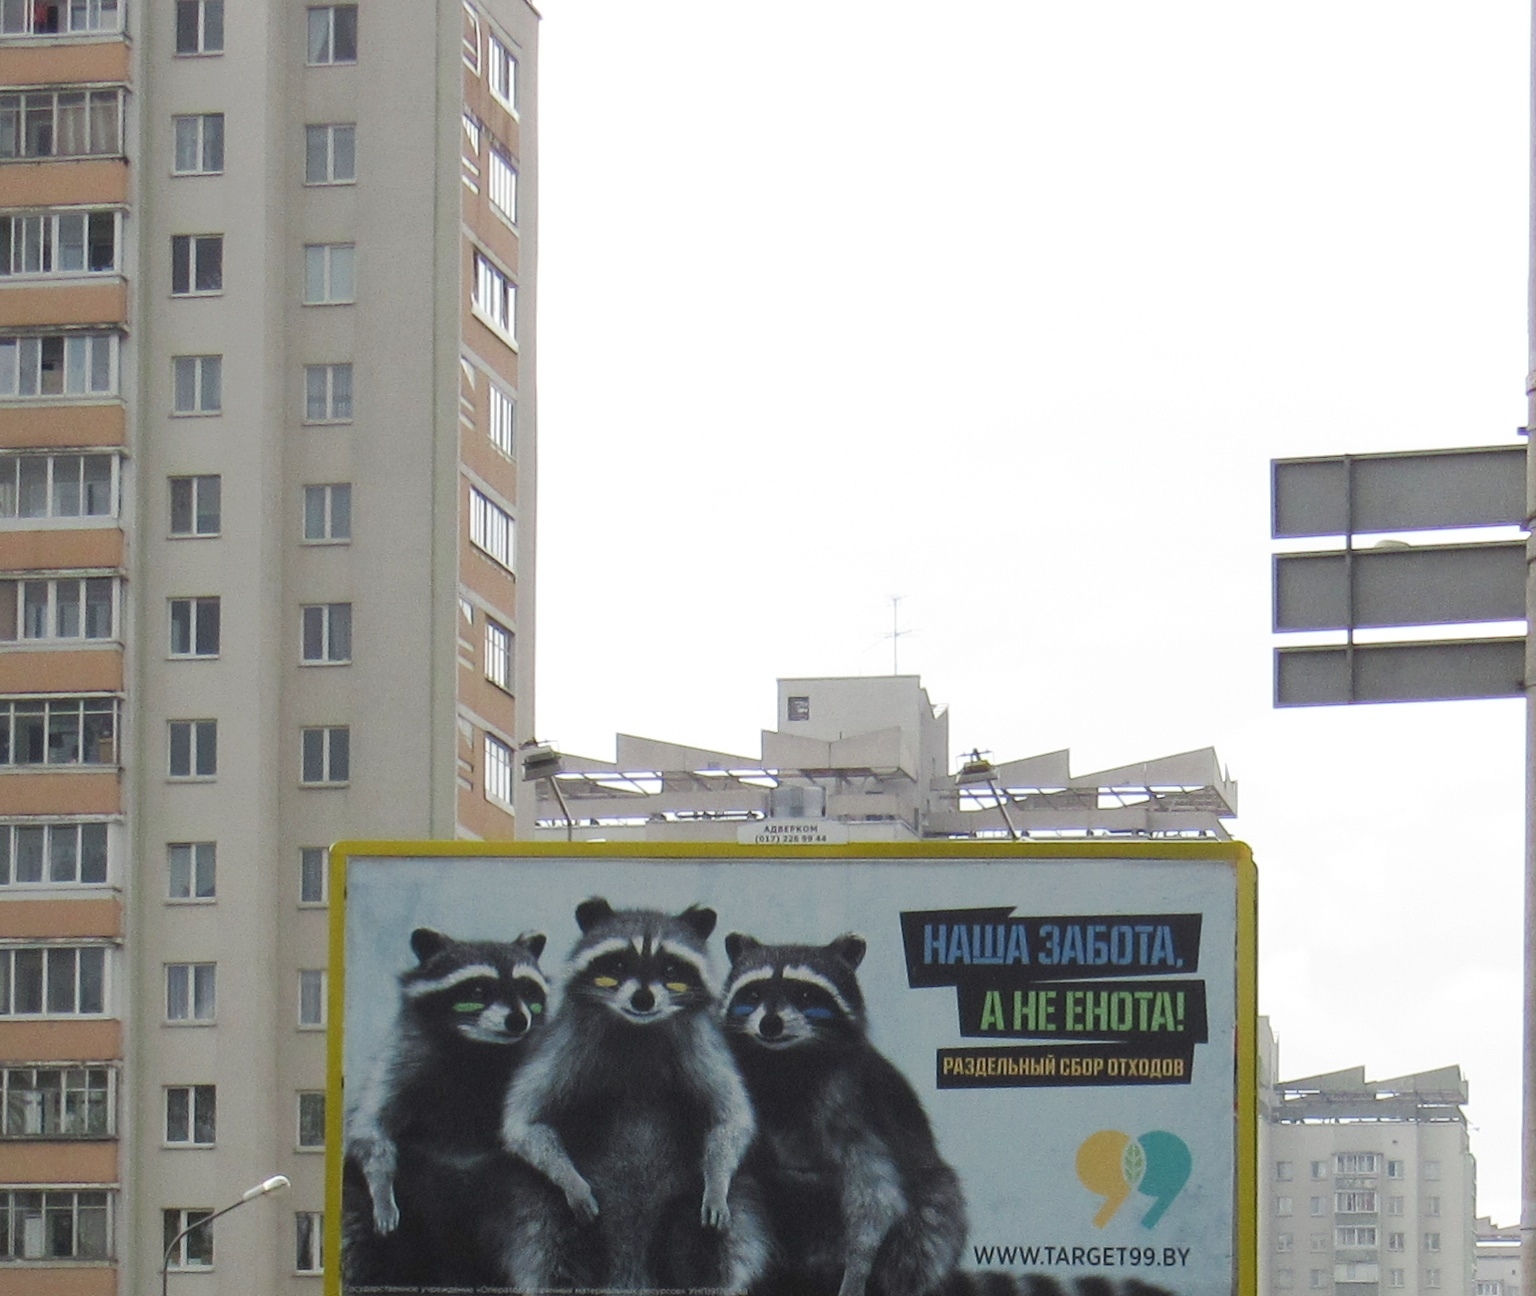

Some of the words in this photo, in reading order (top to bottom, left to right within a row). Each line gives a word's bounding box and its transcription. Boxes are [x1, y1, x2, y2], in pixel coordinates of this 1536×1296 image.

[755, 835, 780, 844] (017)
[763, 825, 818, 834] АДВЕРКОМ
[923, 923, 1030, 966] НАША
[1038, 924, 1184, 969] ЗАБОТА,
[980, 990, 1005, 1031] А
[1013, 990, 1057, 1031] НЕ
[1065, 991, 1186, 1032] ЕНОТА!
[943, 1055, 1054, 1077] РАЗДЕЛЬНЫЙ
[1059, 1058, 1104, 1077] СБОР
[1107, 1058, 1184, 1079] ОТХОДОВ
[973, 1245, 1191, 1267] WWW.TARGET99.BY
